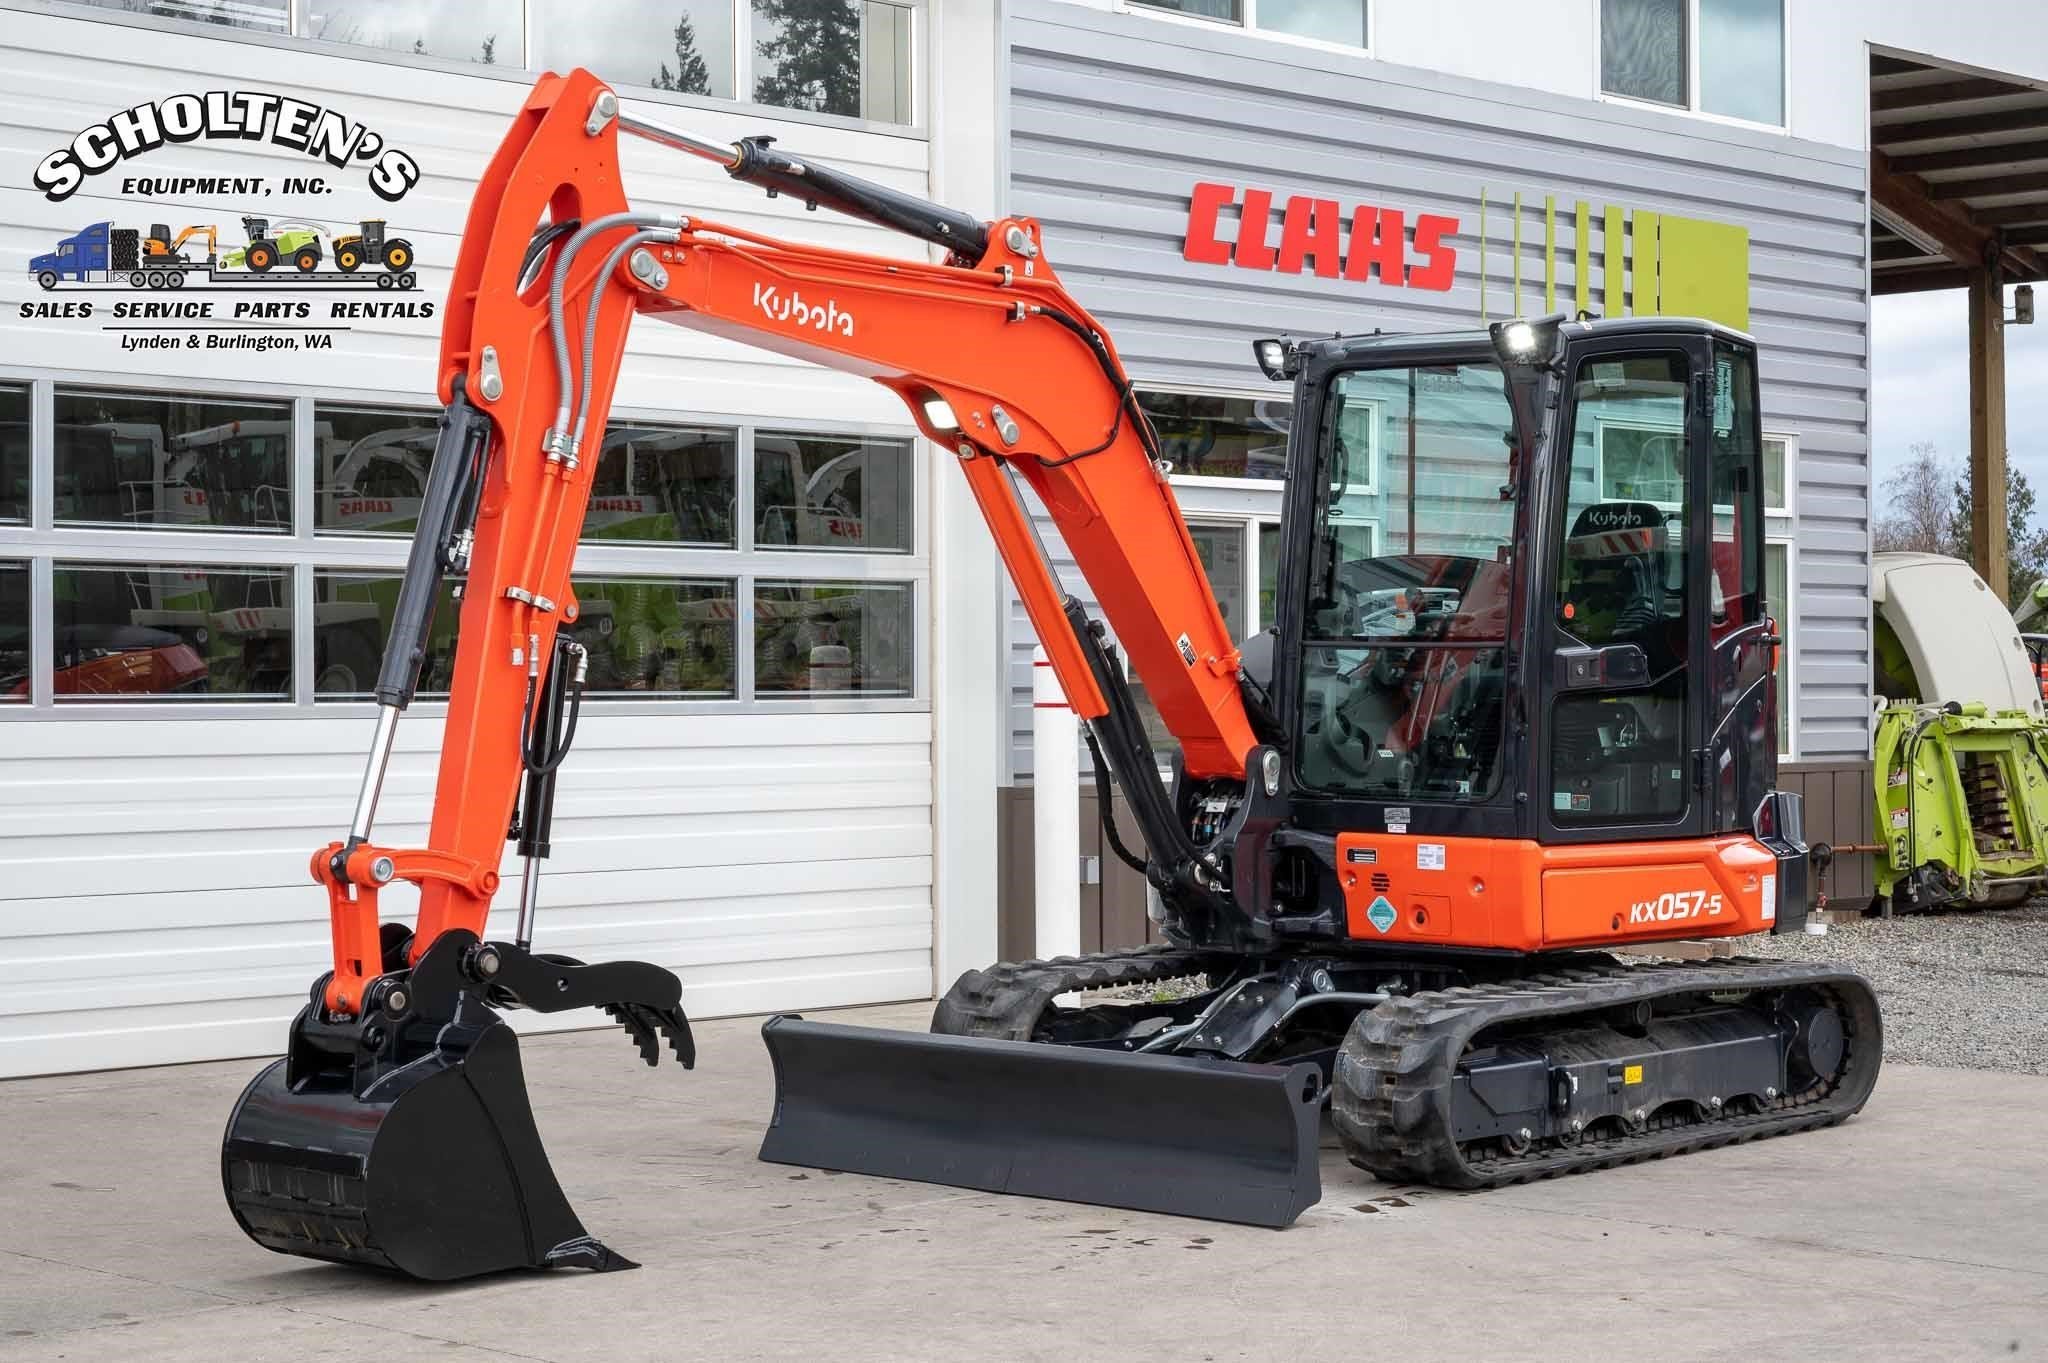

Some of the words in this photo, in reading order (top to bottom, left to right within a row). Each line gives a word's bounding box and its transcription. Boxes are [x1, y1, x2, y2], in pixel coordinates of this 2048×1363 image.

[1183, 182, 1460, 292] CLAAS
[753, 282, 854, 337] Kubota
[1588, 511, 1643, 527] Kubota
[1629, 890, 1722, 924] KX057-5
